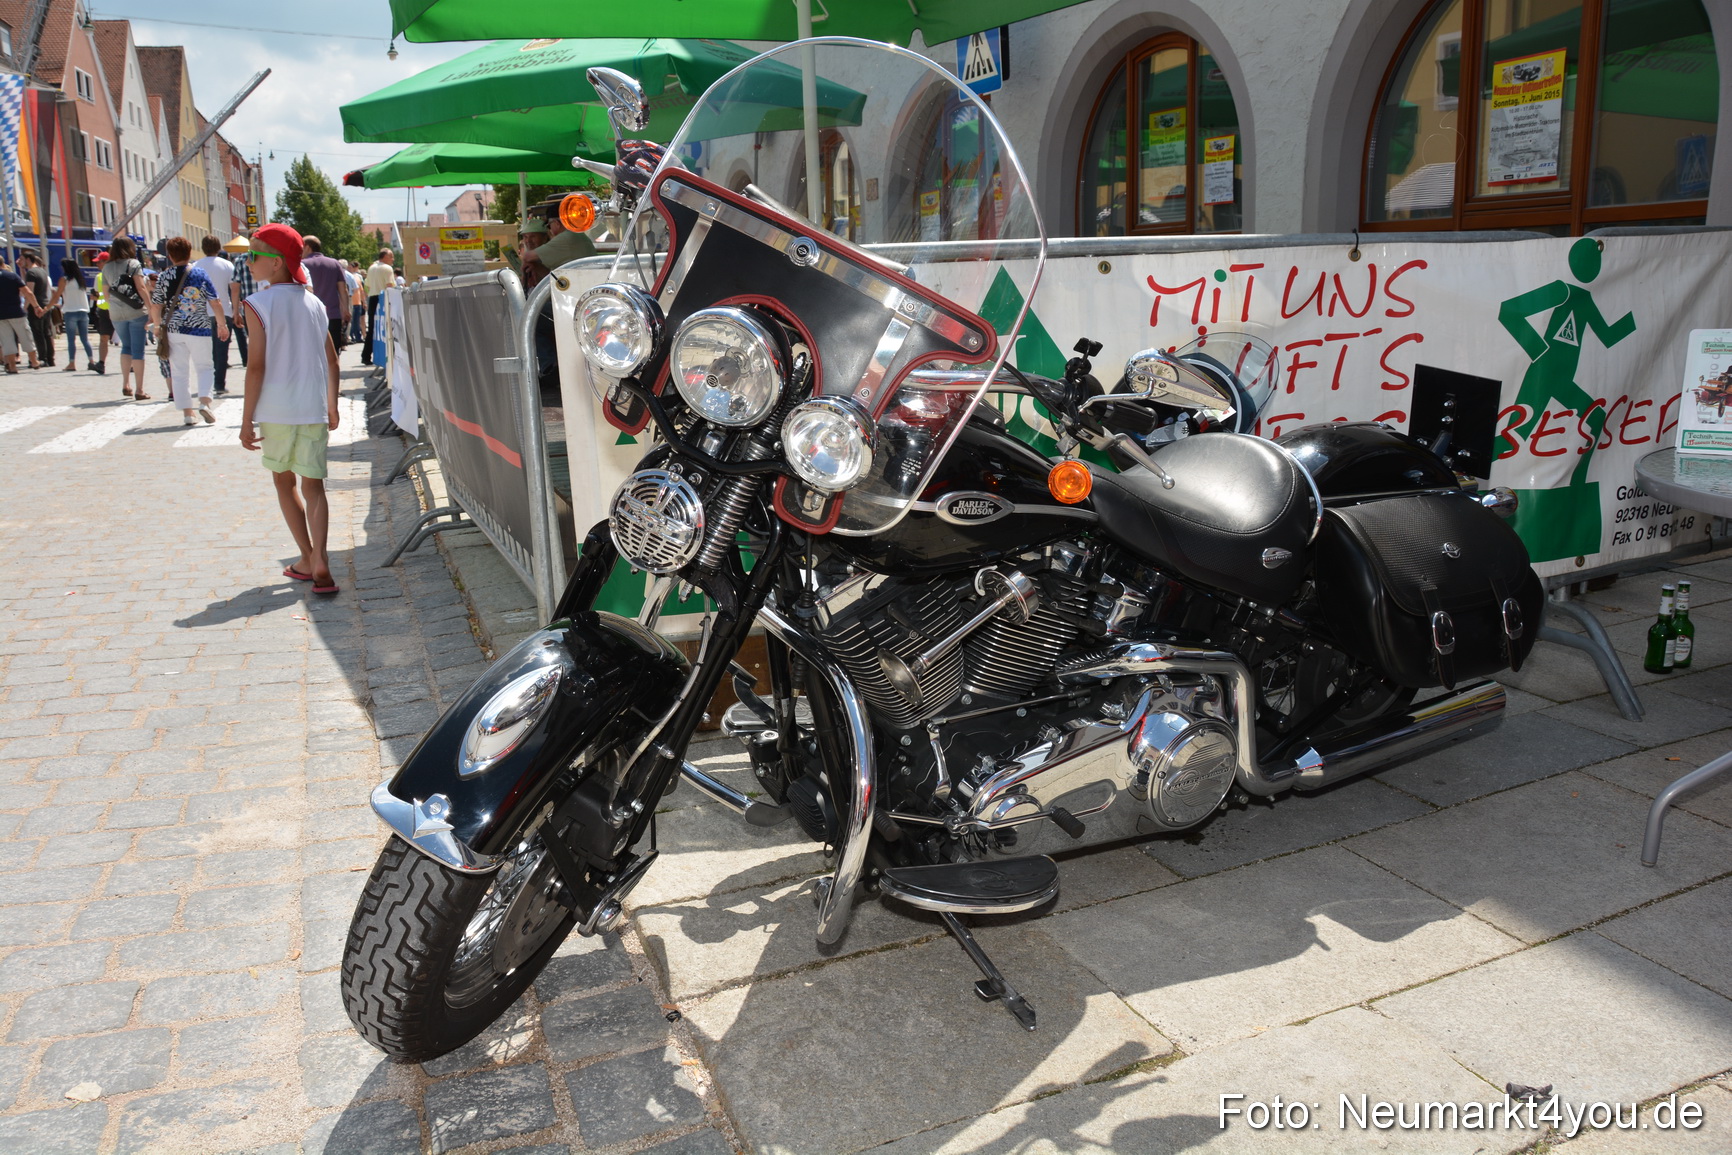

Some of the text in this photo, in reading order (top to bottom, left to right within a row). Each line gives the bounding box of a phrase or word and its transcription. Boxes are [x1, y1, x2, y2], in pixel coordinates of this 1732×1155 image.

[439, 54, 577, 83] Lammsbräu
[1493, 98, 1520, 108] Sonntag,
[1529, 93, 1543, 102] Juni
[1544, 89, 1560, 99] 2015
[1281, 259, 1428, 319] UNS
[1687, 432, 1713, 440] Technik
[952, 507, 994, 515] DAVIDSON
[958, 500, 994, 508] HARLEY-
[1615, 502, 1680, 523] 92318 Neu
[1612, 531, 1631, 546] Fax
[1647, 524, 1658, 539] 91
[1680, 516, 1695, 530] 48
